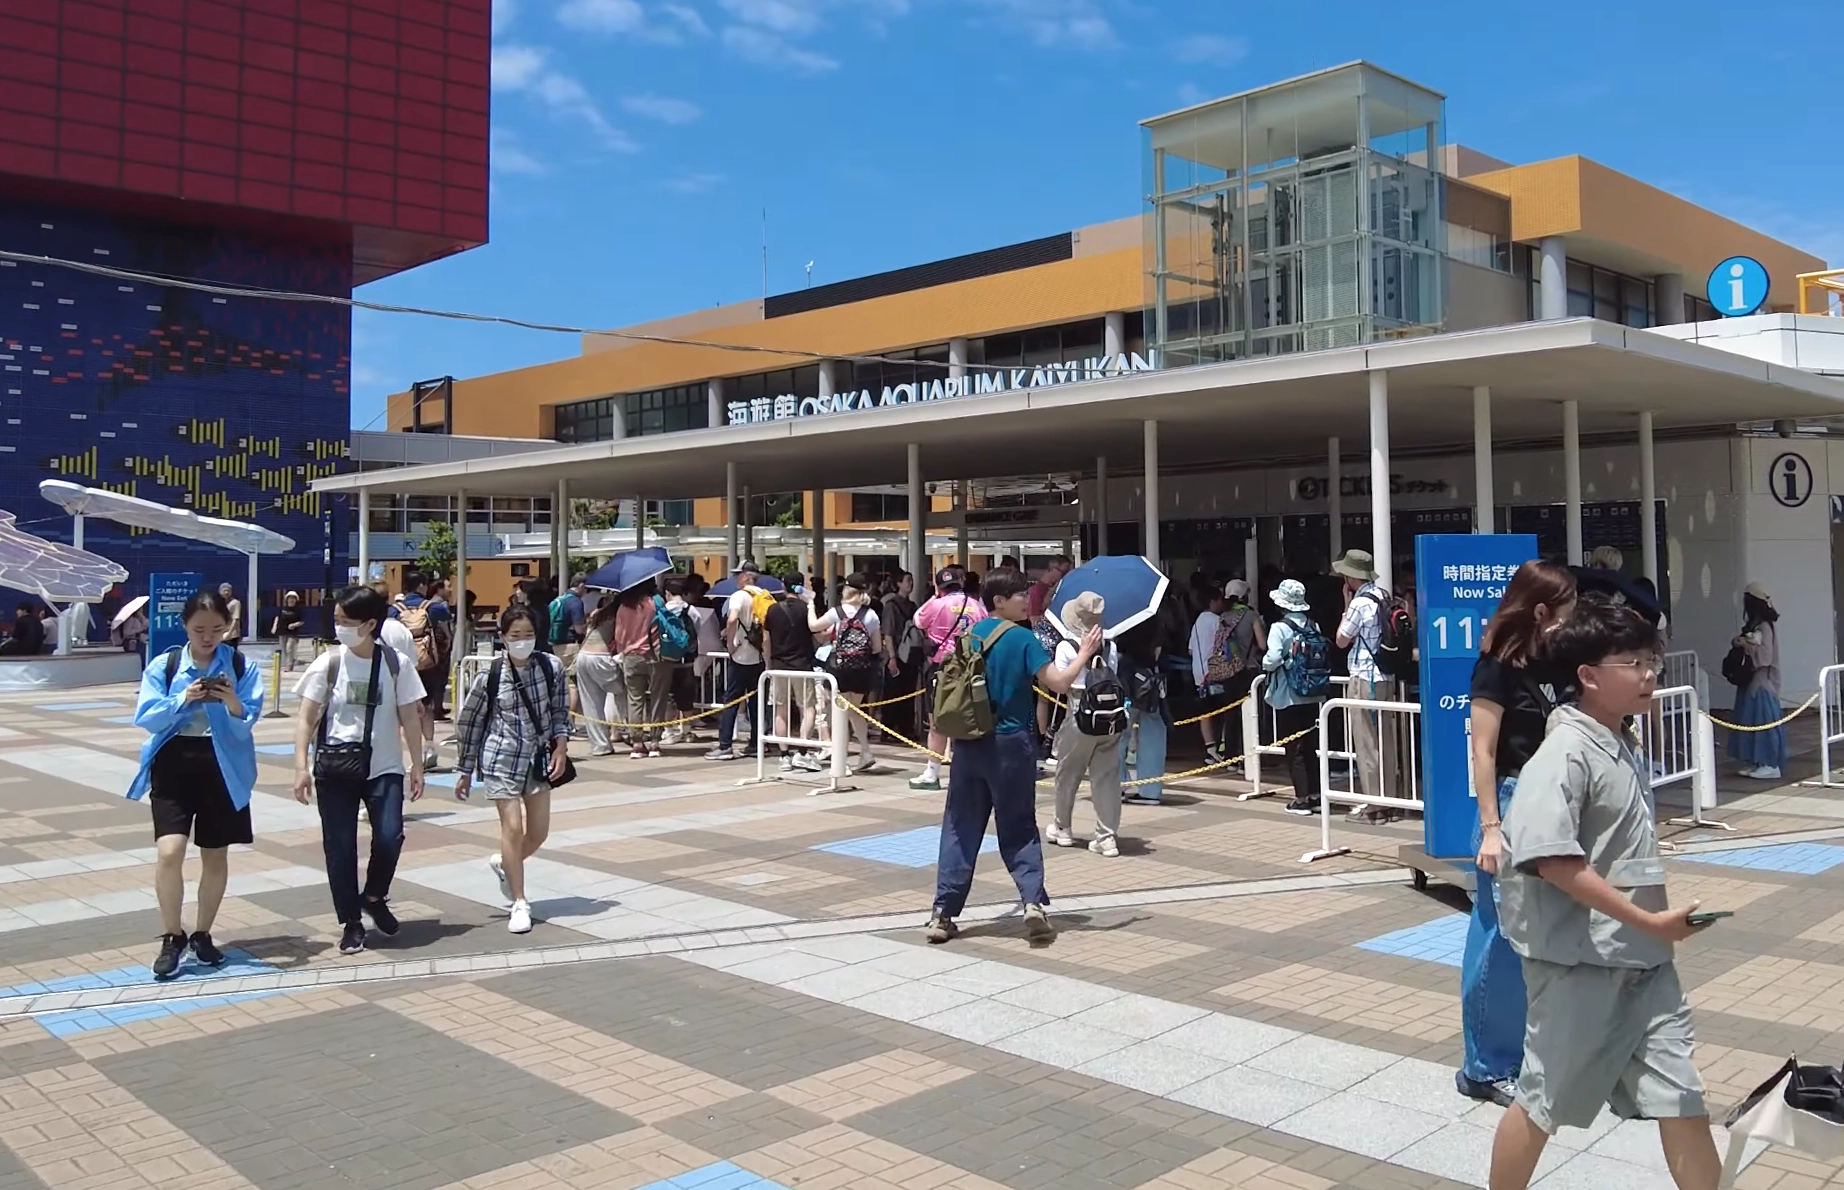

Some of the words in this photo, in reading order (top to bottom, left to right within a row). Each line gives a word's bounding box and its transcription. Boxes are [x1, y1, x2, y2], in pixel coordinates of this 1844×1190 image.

[727, 393, 798, 426] 海遊館
[799, 389, 874, 417] OSAKA
[879, 371, 1007, 406] AQUARIUM
[1010, 349, 1158, 390] KAIYUKAN
[1453, 586, 1485, 599] Now
[1487, 586, 1507, 599] Sal
